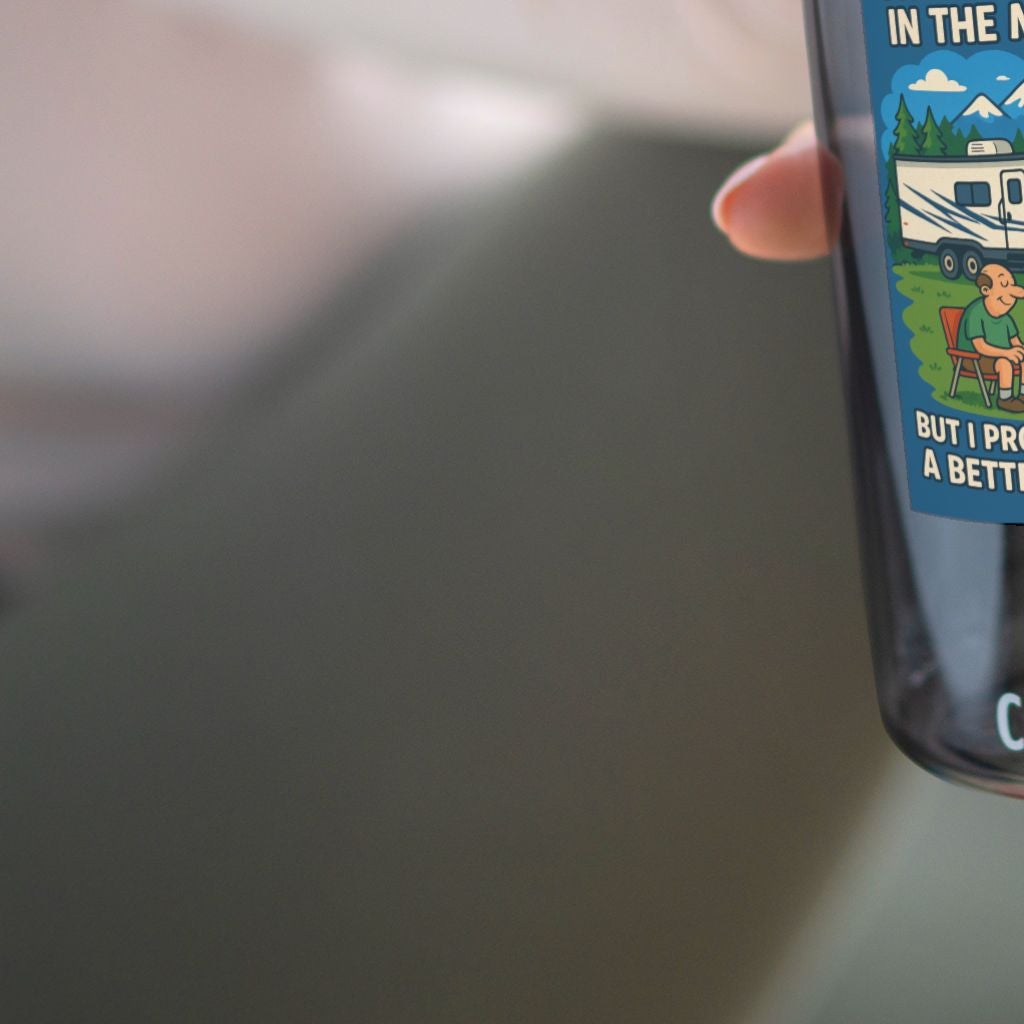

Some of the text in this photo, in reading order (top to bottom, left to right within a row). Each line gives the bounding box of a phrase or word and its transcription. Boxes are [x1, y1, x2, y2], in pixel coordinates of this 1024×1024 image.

[888, 8, 920, 45] IN
[928, 5, 998, 44] THE
[916, 410, 961, 446] BUT
[967, 422, 976, 449] I
[923, 448, 942, 481] A
